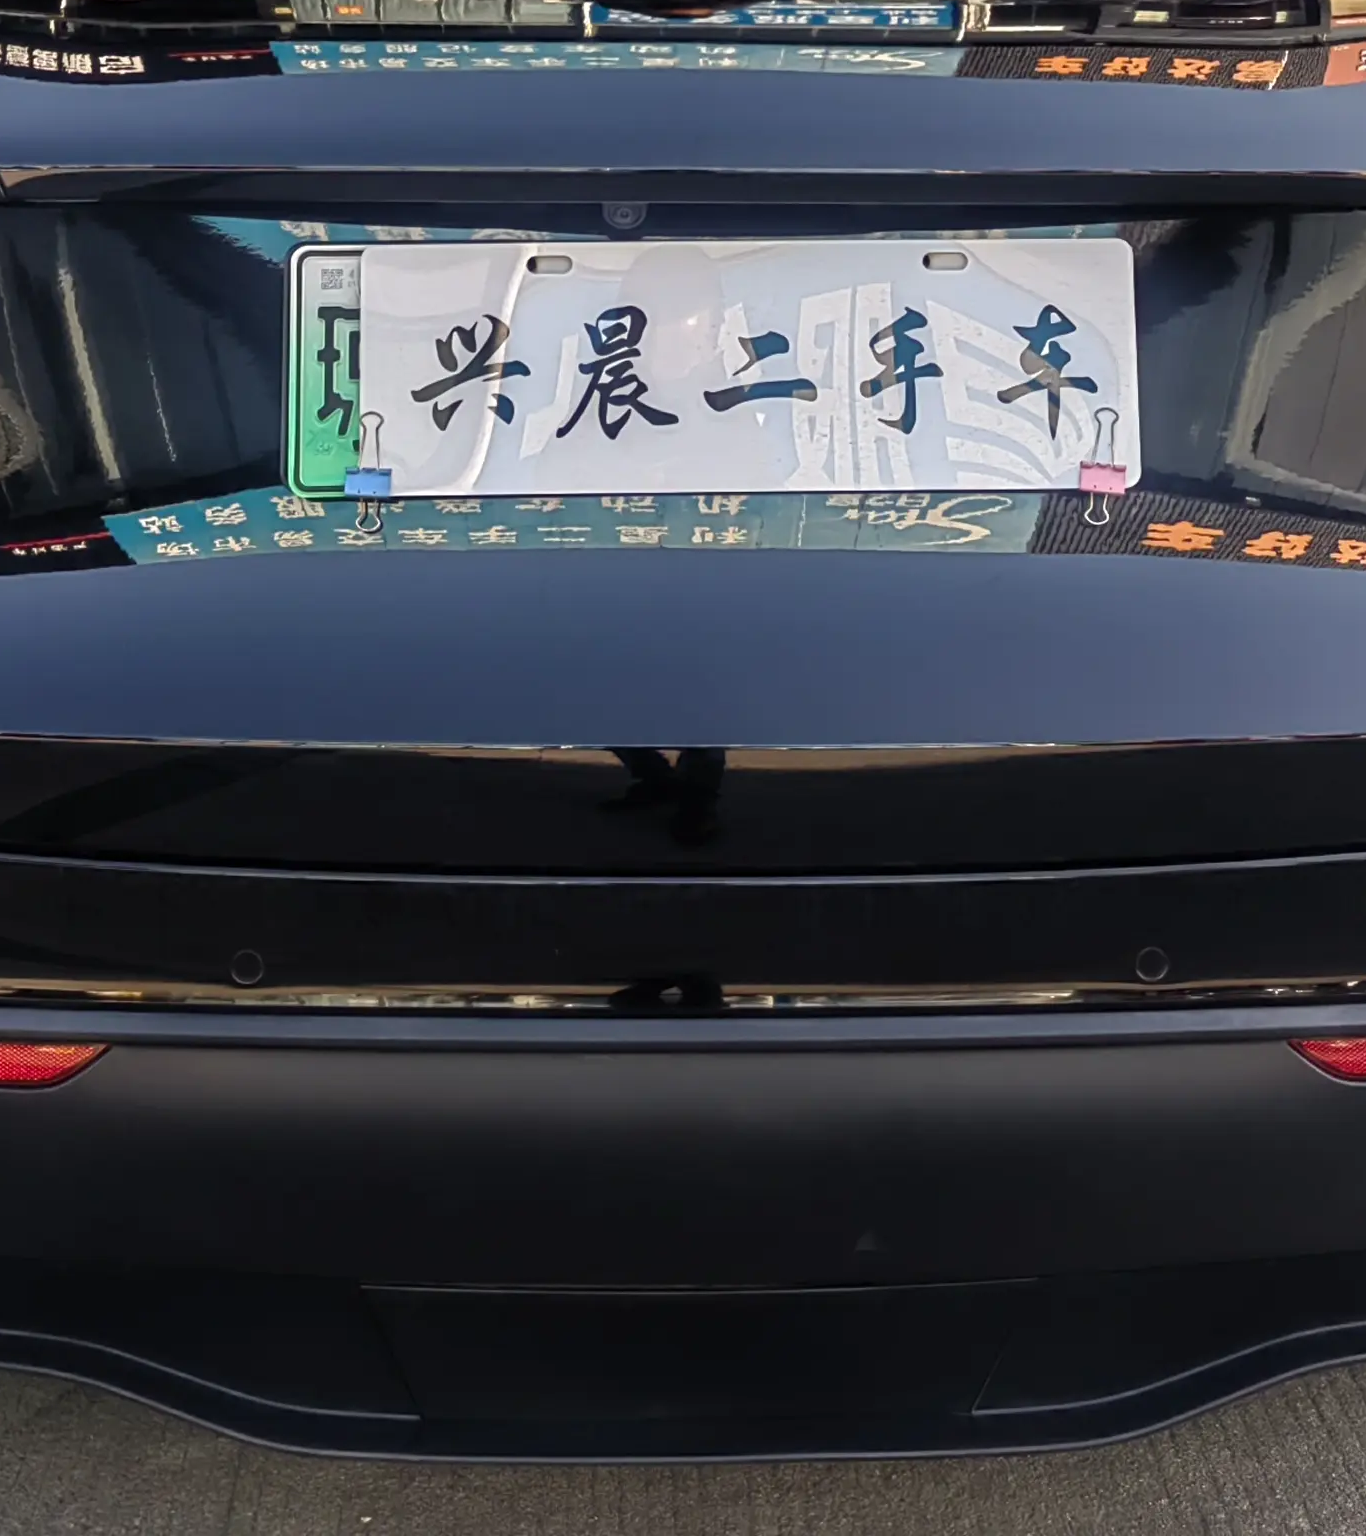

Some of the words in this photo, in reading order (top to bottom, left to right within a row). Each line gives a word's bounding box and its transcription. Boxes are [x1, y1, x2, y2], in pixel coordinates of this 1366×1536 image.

[410, 304, 1098, 440] 兴晨二手车
